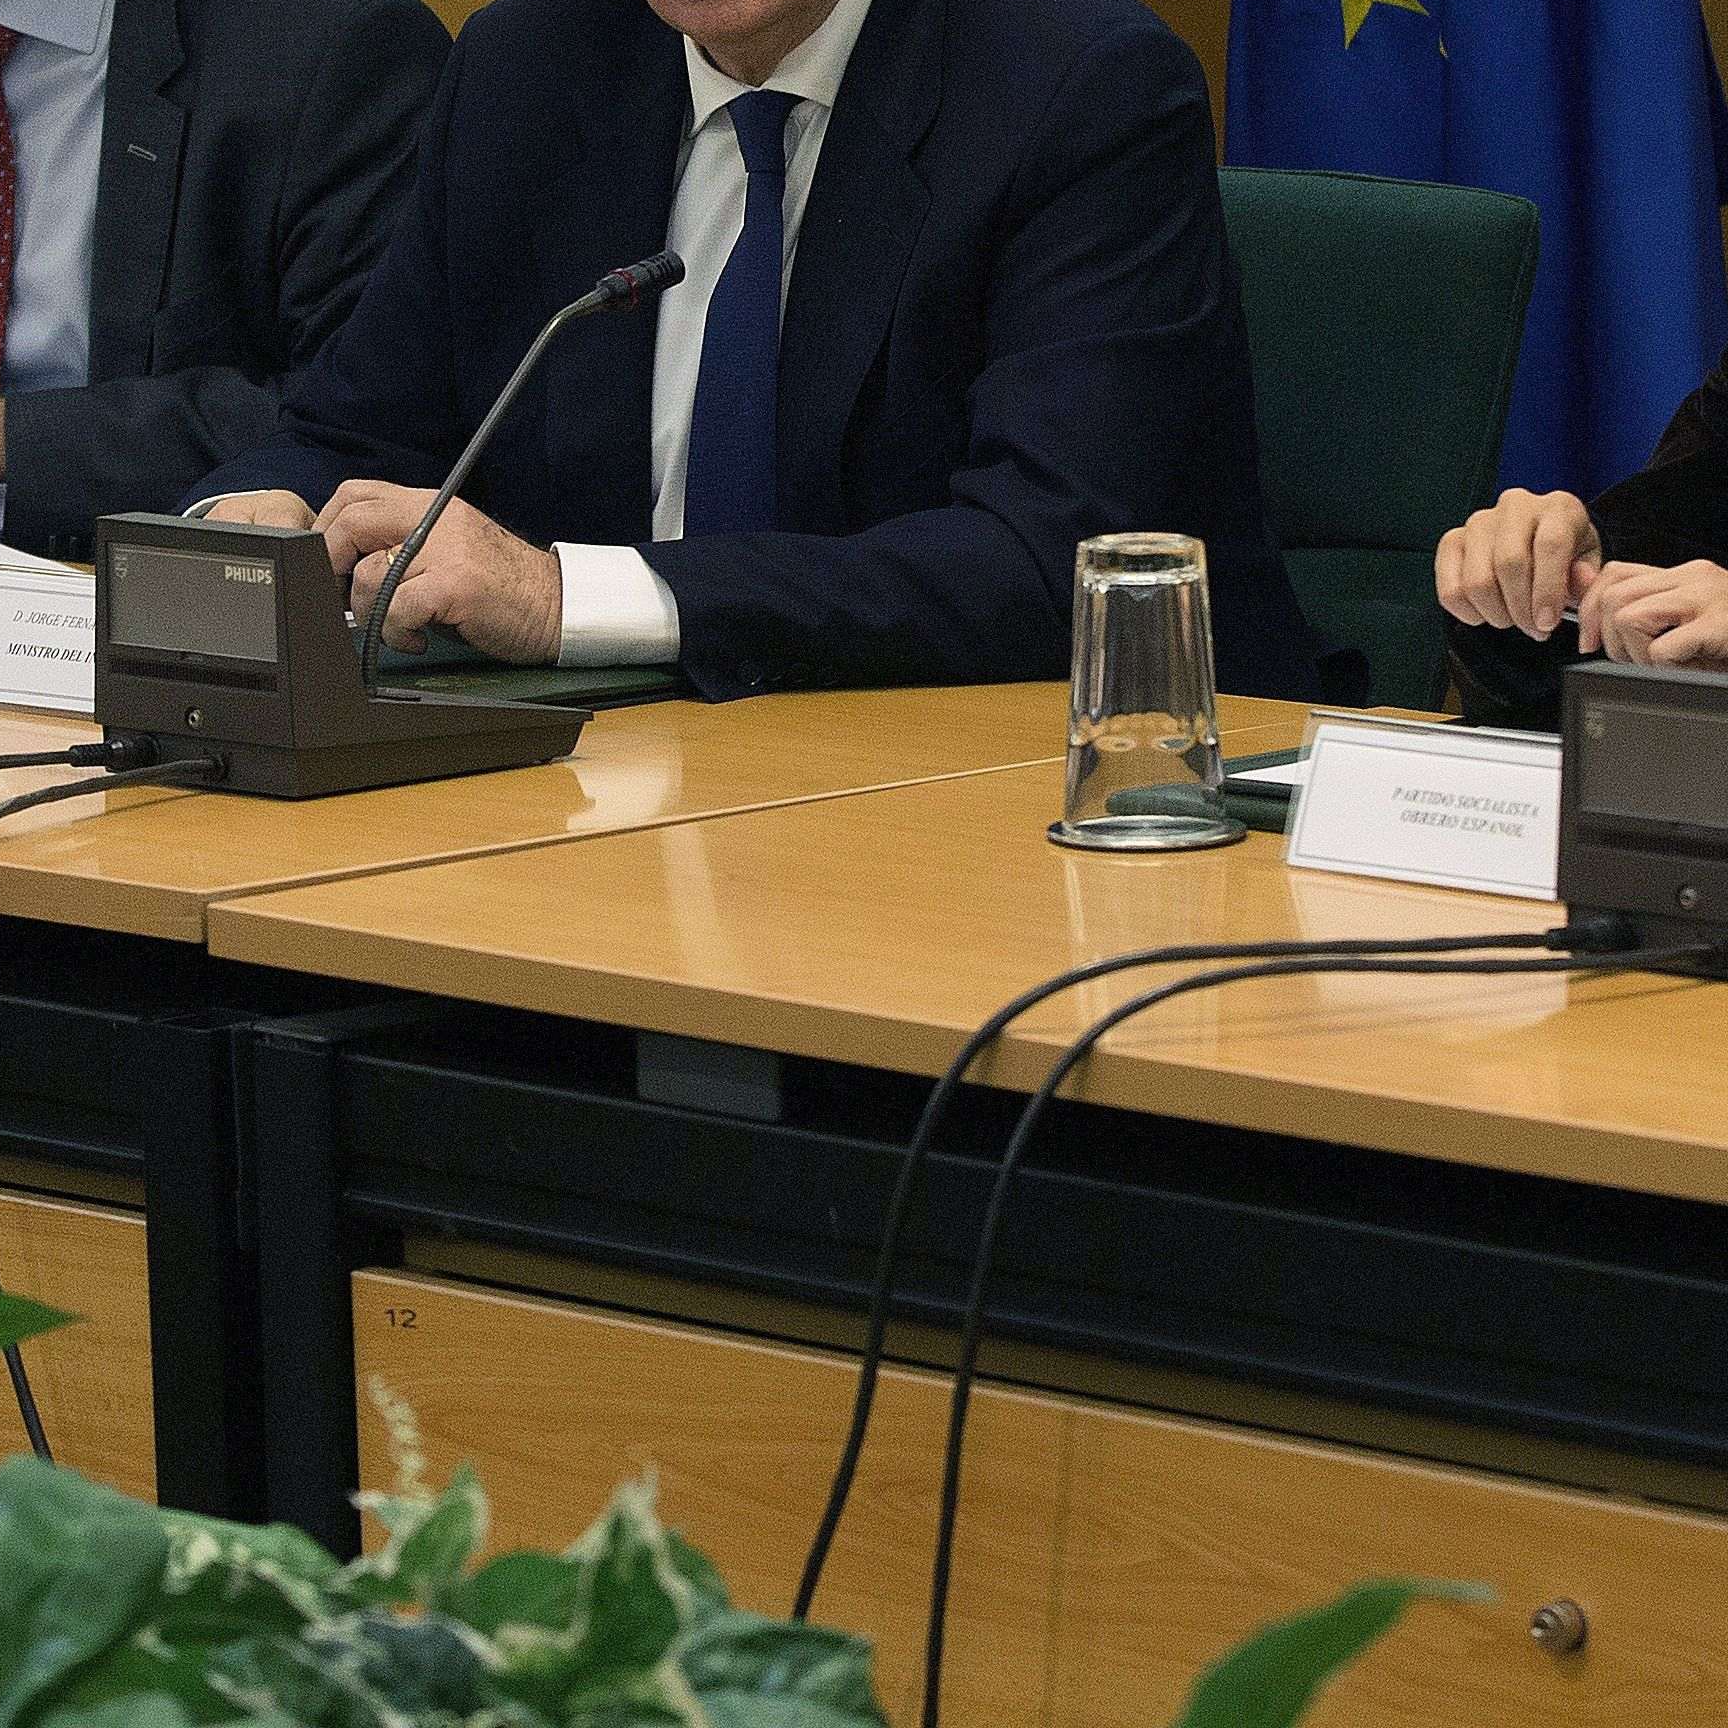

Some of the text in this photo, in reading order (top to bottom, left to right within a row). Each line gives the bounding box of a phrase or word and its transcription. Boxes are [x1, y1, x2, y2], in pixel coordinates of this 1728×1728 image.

[224, 565, 273, 584] PHILIPS
[25, 611, 62, 626] JORGE
[7, 642, 60, 659] MINISTRO
[60, 648, 83, 662] DEL
[384, 1307, 417, 1329] 12
